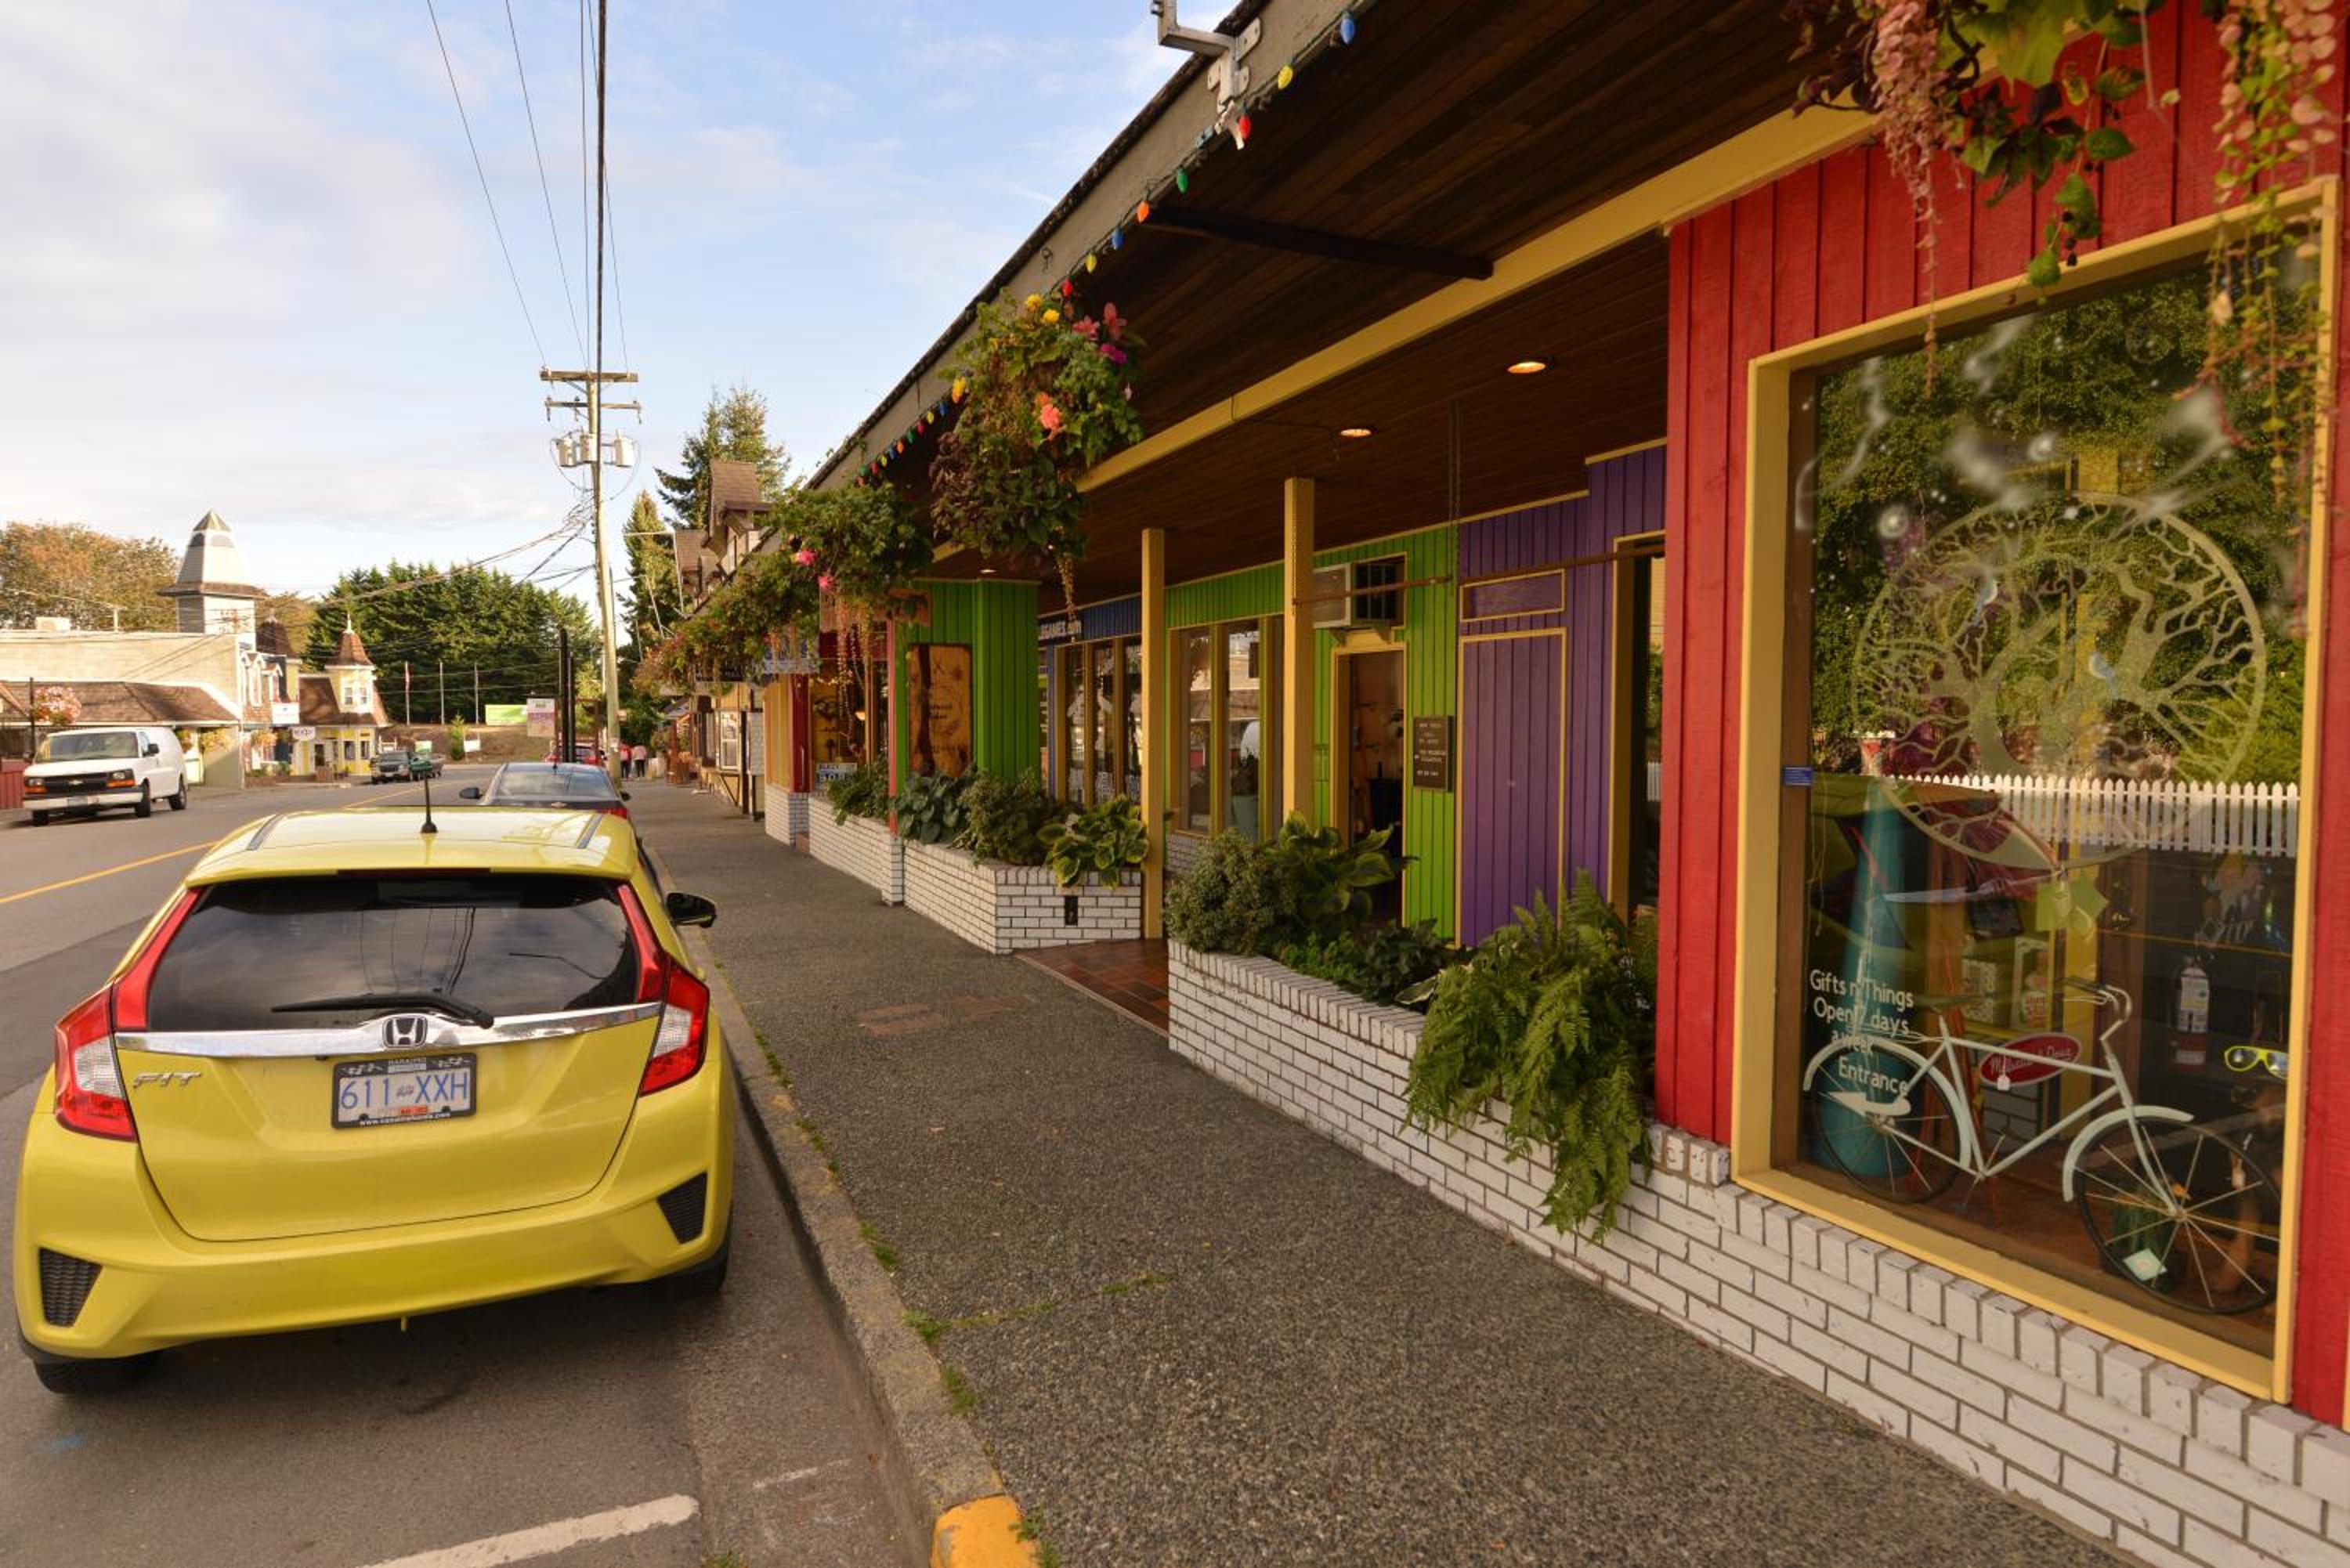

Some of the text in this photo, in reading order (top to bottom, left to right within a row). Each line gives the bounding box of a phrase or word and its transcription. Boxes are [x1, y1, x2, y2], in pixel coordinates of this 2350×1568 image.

[1810, 969, 1846, 995] Gifts
[1864, 977, 1914, 1012] Things
[1813, 996, 1855, 1024] Open
[1871, 1007, 1909, 1039] days
[133, 1071, 201, 1088] FIT
[341, 1071, 468, 1110] 611 XXH
[1838, 1056, 1909, 1093] Entrance
